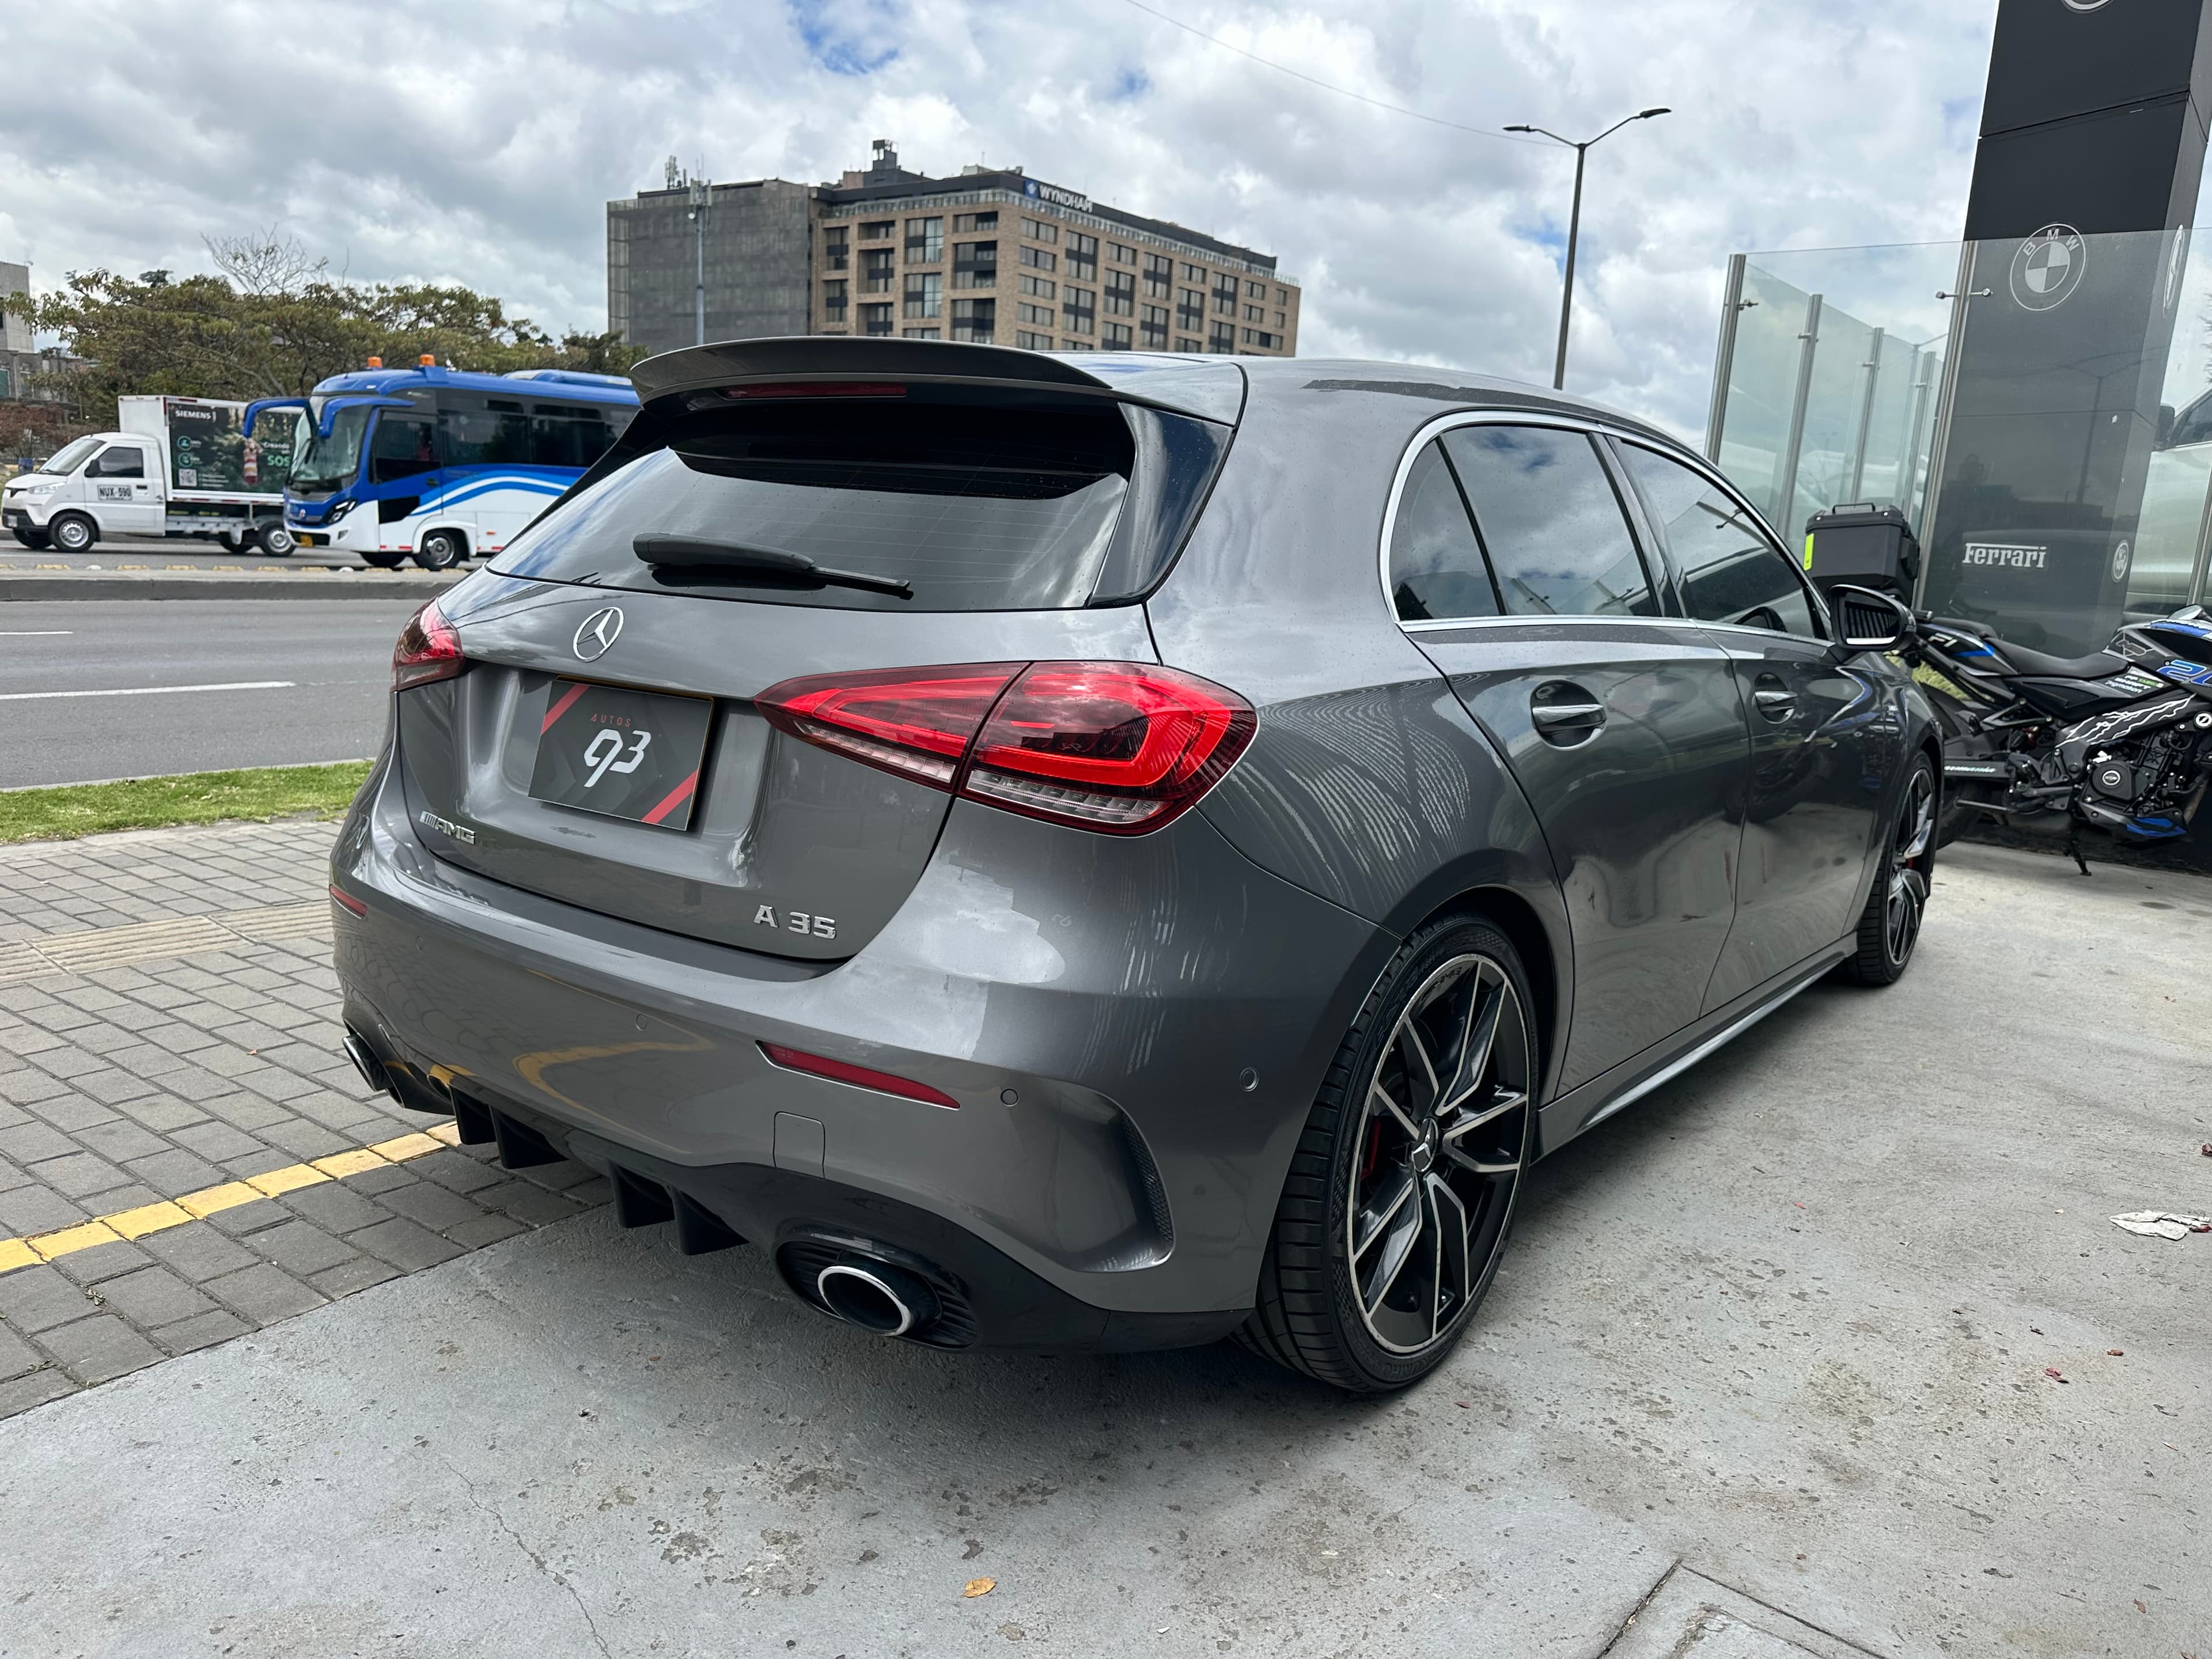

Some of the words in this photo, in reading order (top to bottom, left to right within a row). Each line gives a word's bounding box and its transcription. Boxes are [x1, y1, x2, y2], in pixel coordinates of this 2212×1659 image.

[1039, 184, 1093, 213] WYNDHAM
[2022, 228, 2080, 256] BMW
[175, 410, 211, 419] SIEMENS
[1962, 543, 2047, 567] Ferrari
[590, 714, 631, 727] AUTOS
[584, 729, 652, 787] 93
[435, 817, 475, 844] AMG
[754, 905, 778, 928] A
[788, 912, 836, 939] 35
